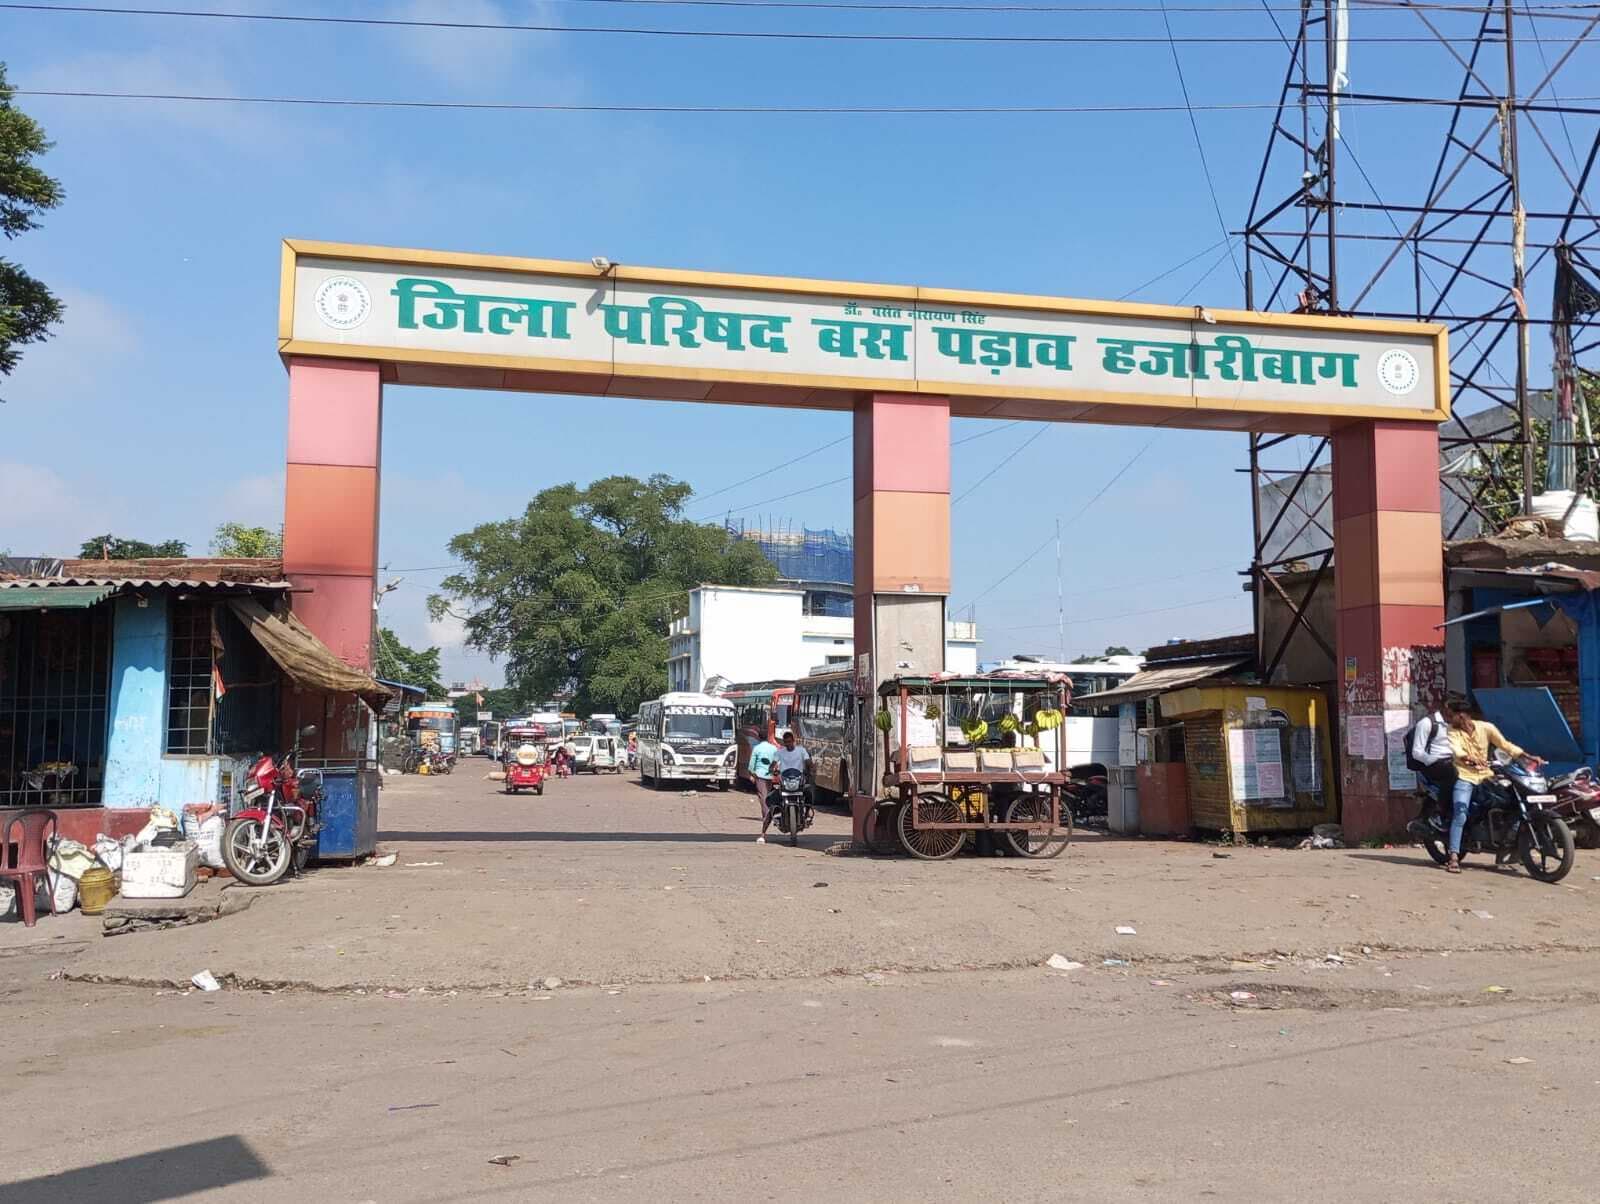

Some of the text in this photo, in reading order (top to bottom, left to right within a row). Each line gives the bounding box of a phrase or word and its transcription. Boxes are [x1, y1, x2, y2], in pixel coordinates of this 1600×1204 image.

[960, 310, 986, 325] सिंह
[390, 278, 577, 340] जिला
[598, 296, 792, 353] परिषद
[811, 318, 913, 361] बस
[931, 326, 1077, 375] पड़ाव
[1096, 335, 1360, 388] हजारीबाग
[670, 706, 732, 716] KARAN
